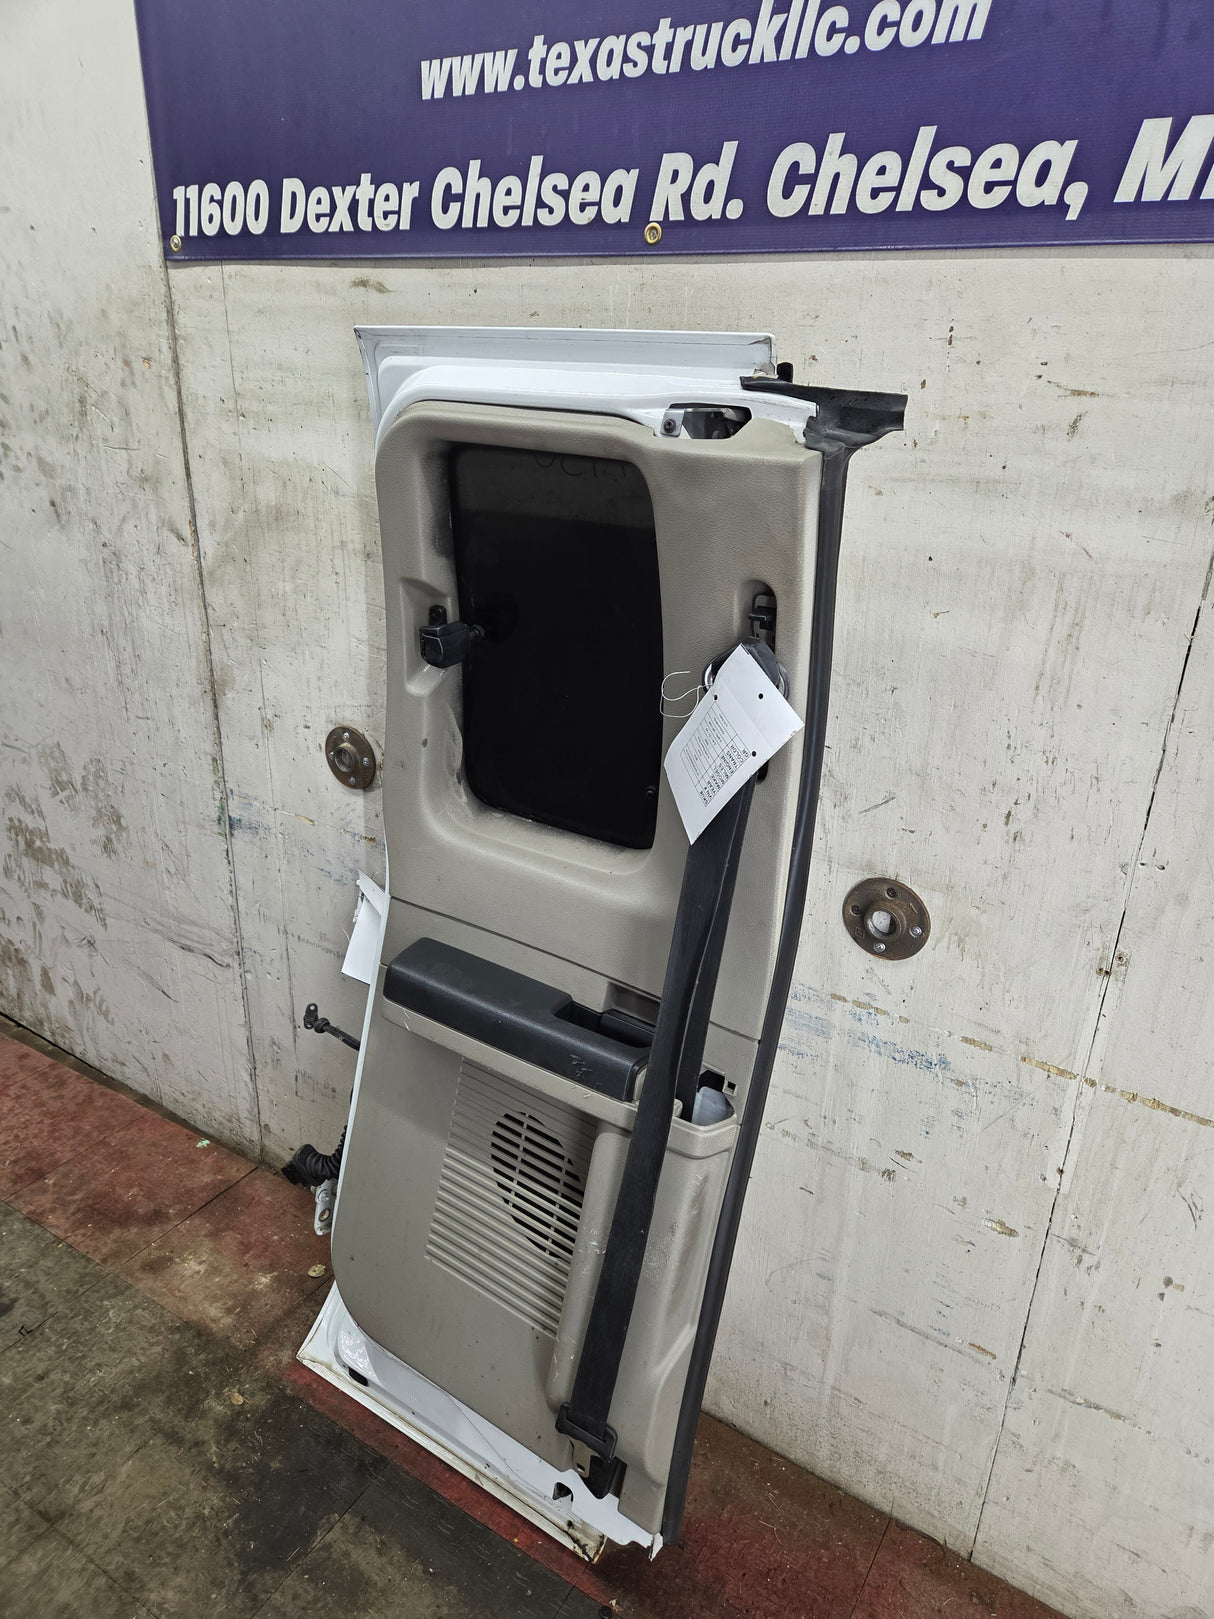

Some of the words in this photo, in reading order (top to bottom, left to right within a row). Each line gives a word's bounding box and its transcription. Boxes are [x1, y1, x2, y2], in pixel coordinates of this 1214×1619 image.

[420, 0, 991, 100] www.texastruckllc.com
[173, 178, 270, 237] 11600
[280, 173, 420, 234] Dexter
[431, 155, 640, 230] Chelsea
[649, 141, 744, 222] Rd.
[766, 125, 1089, 221] Chelsea,
[720, 752, 734, 775] ENGINE
[725, 749, 738, 769] TRANS
[729, 742, 744, 764] COLOR
[712, 764, 725, 785] MODEL
[717, 761, 729, 780] MILES
